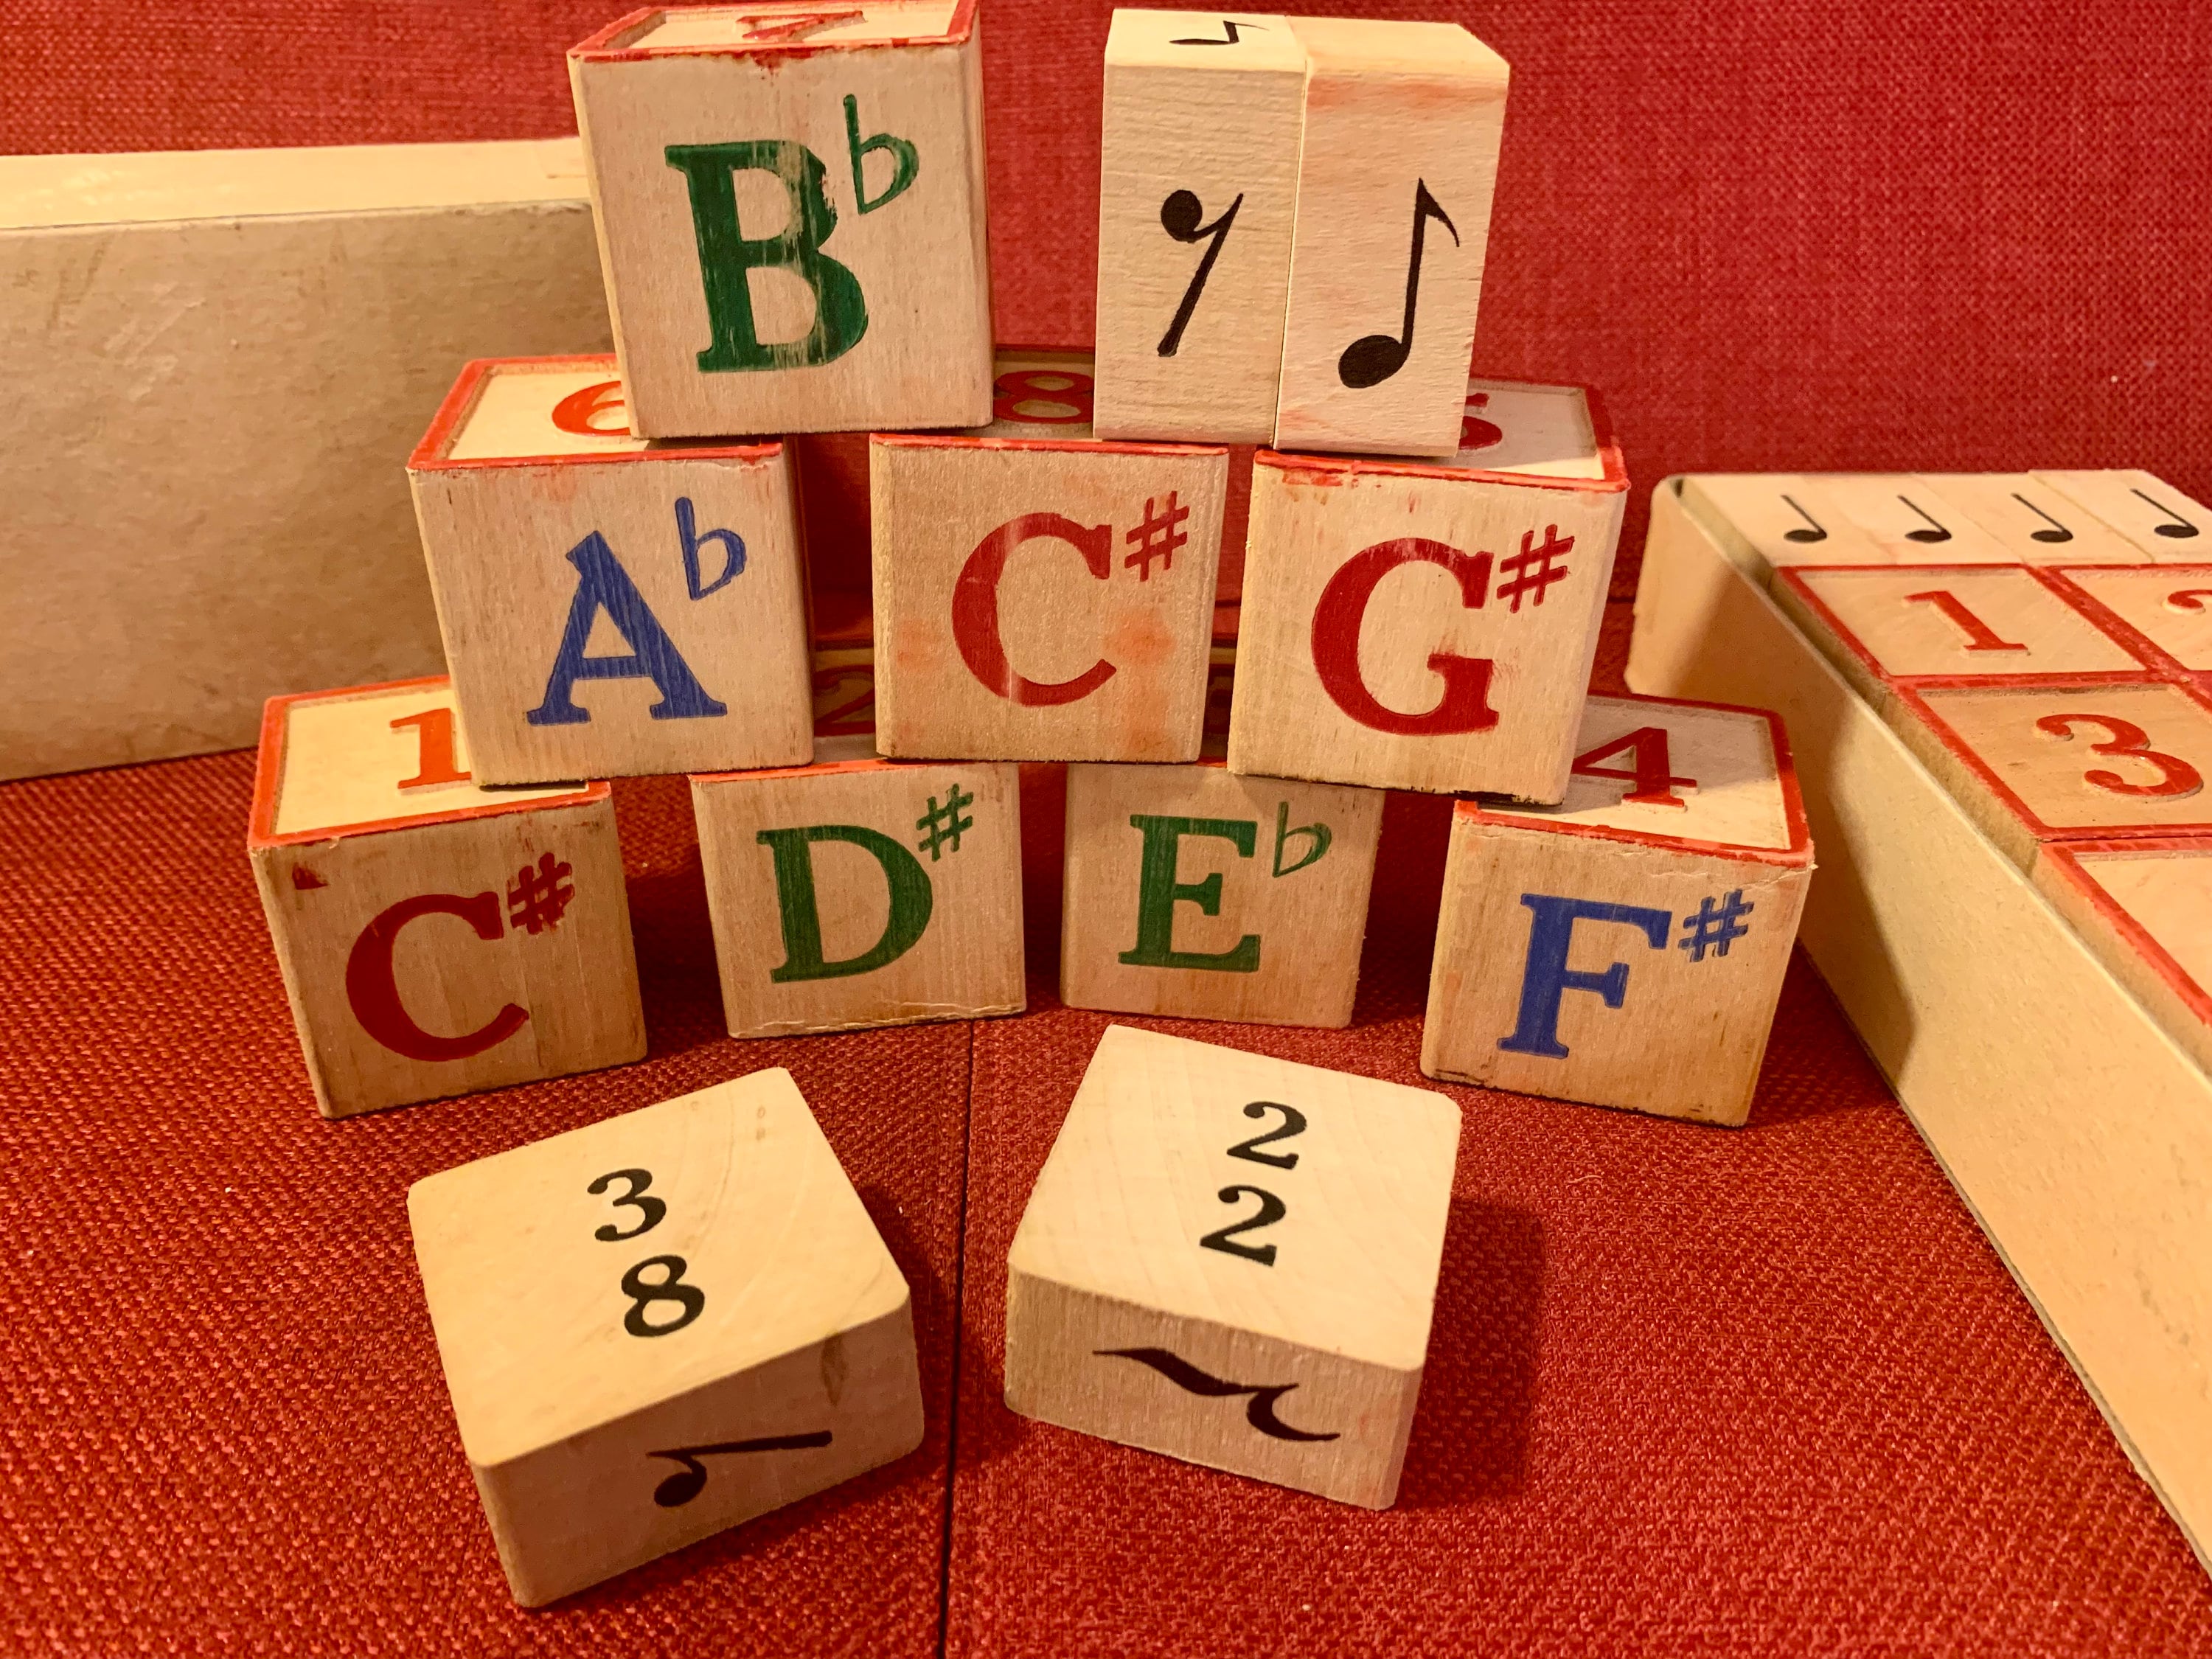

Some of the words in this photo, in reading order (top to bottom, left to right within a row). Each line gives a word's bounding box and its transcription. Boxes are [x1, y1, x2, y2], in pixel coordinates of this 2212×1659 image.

[993, 370, 1095, 424] 8
[1903, 591, 2028, 653] 1
[1572, 726, 1697, 807] 4
[2035, 713, 2205, 798] 3
[1227, 1101, 1308, 1170] 2
[587, 1167, 666, 1242] 3
[1200, 1185, 1287, 1267] 2
[620, 1253, 706, 1338] 8
